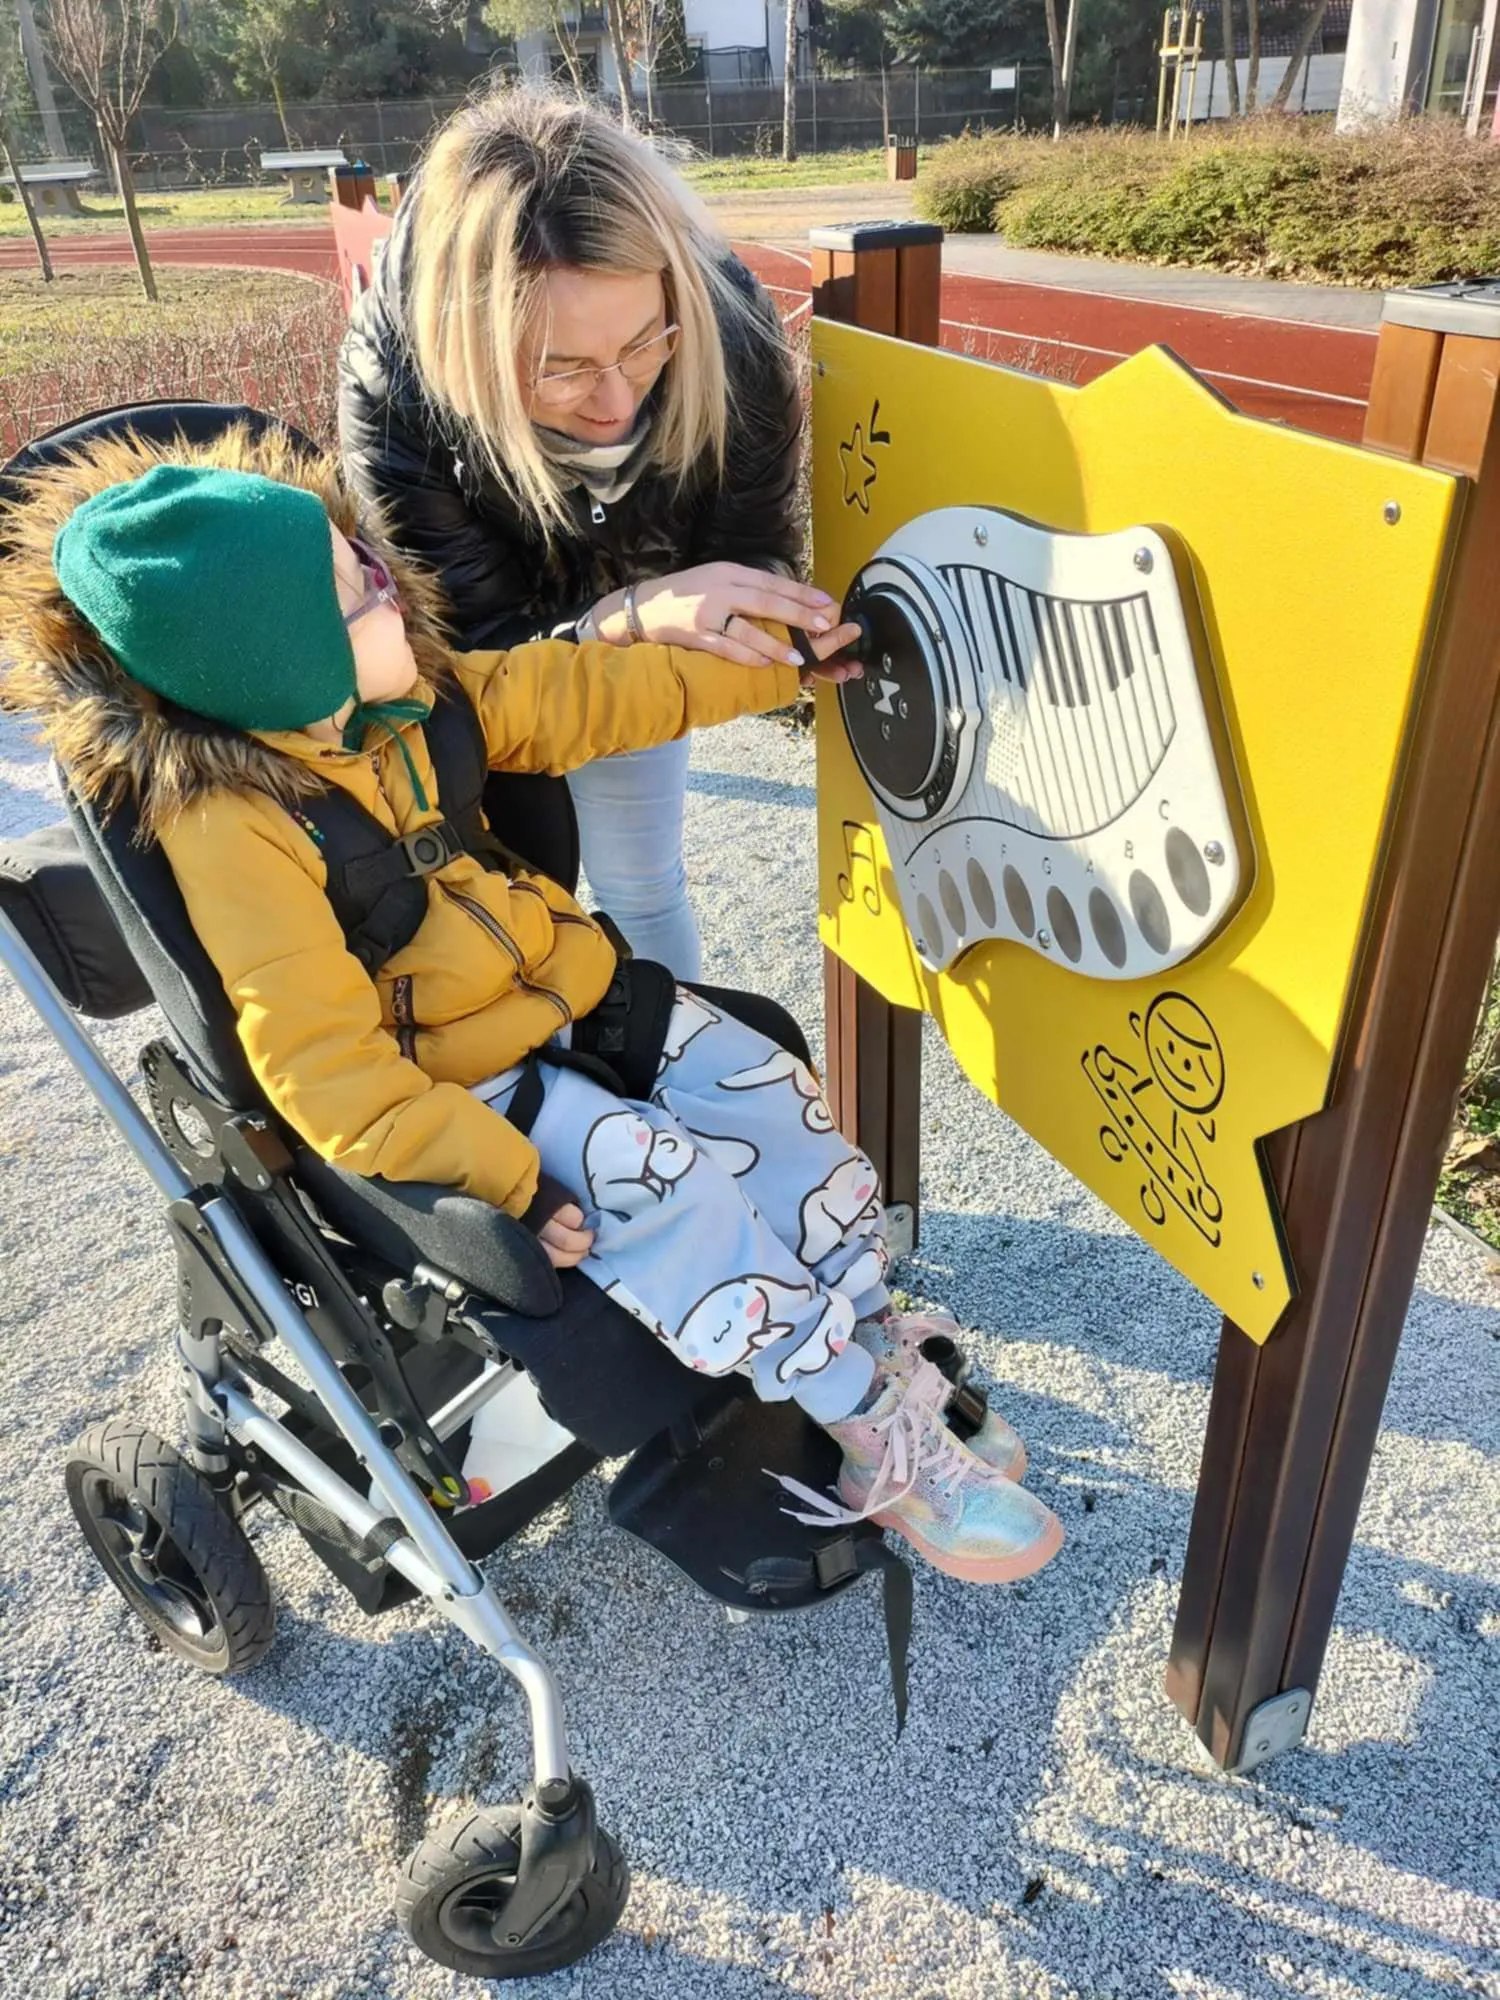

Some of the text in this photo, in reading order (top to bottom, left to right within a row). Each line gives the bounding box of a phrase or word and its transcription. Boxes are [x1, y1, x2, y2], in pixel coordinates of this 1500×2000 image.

[1042, 856, 1052, 875] G
[1124, 840, 1134, 860] B
[1158, 798, 1170, 821] C
[283, 1278, 319, 1308] GI
